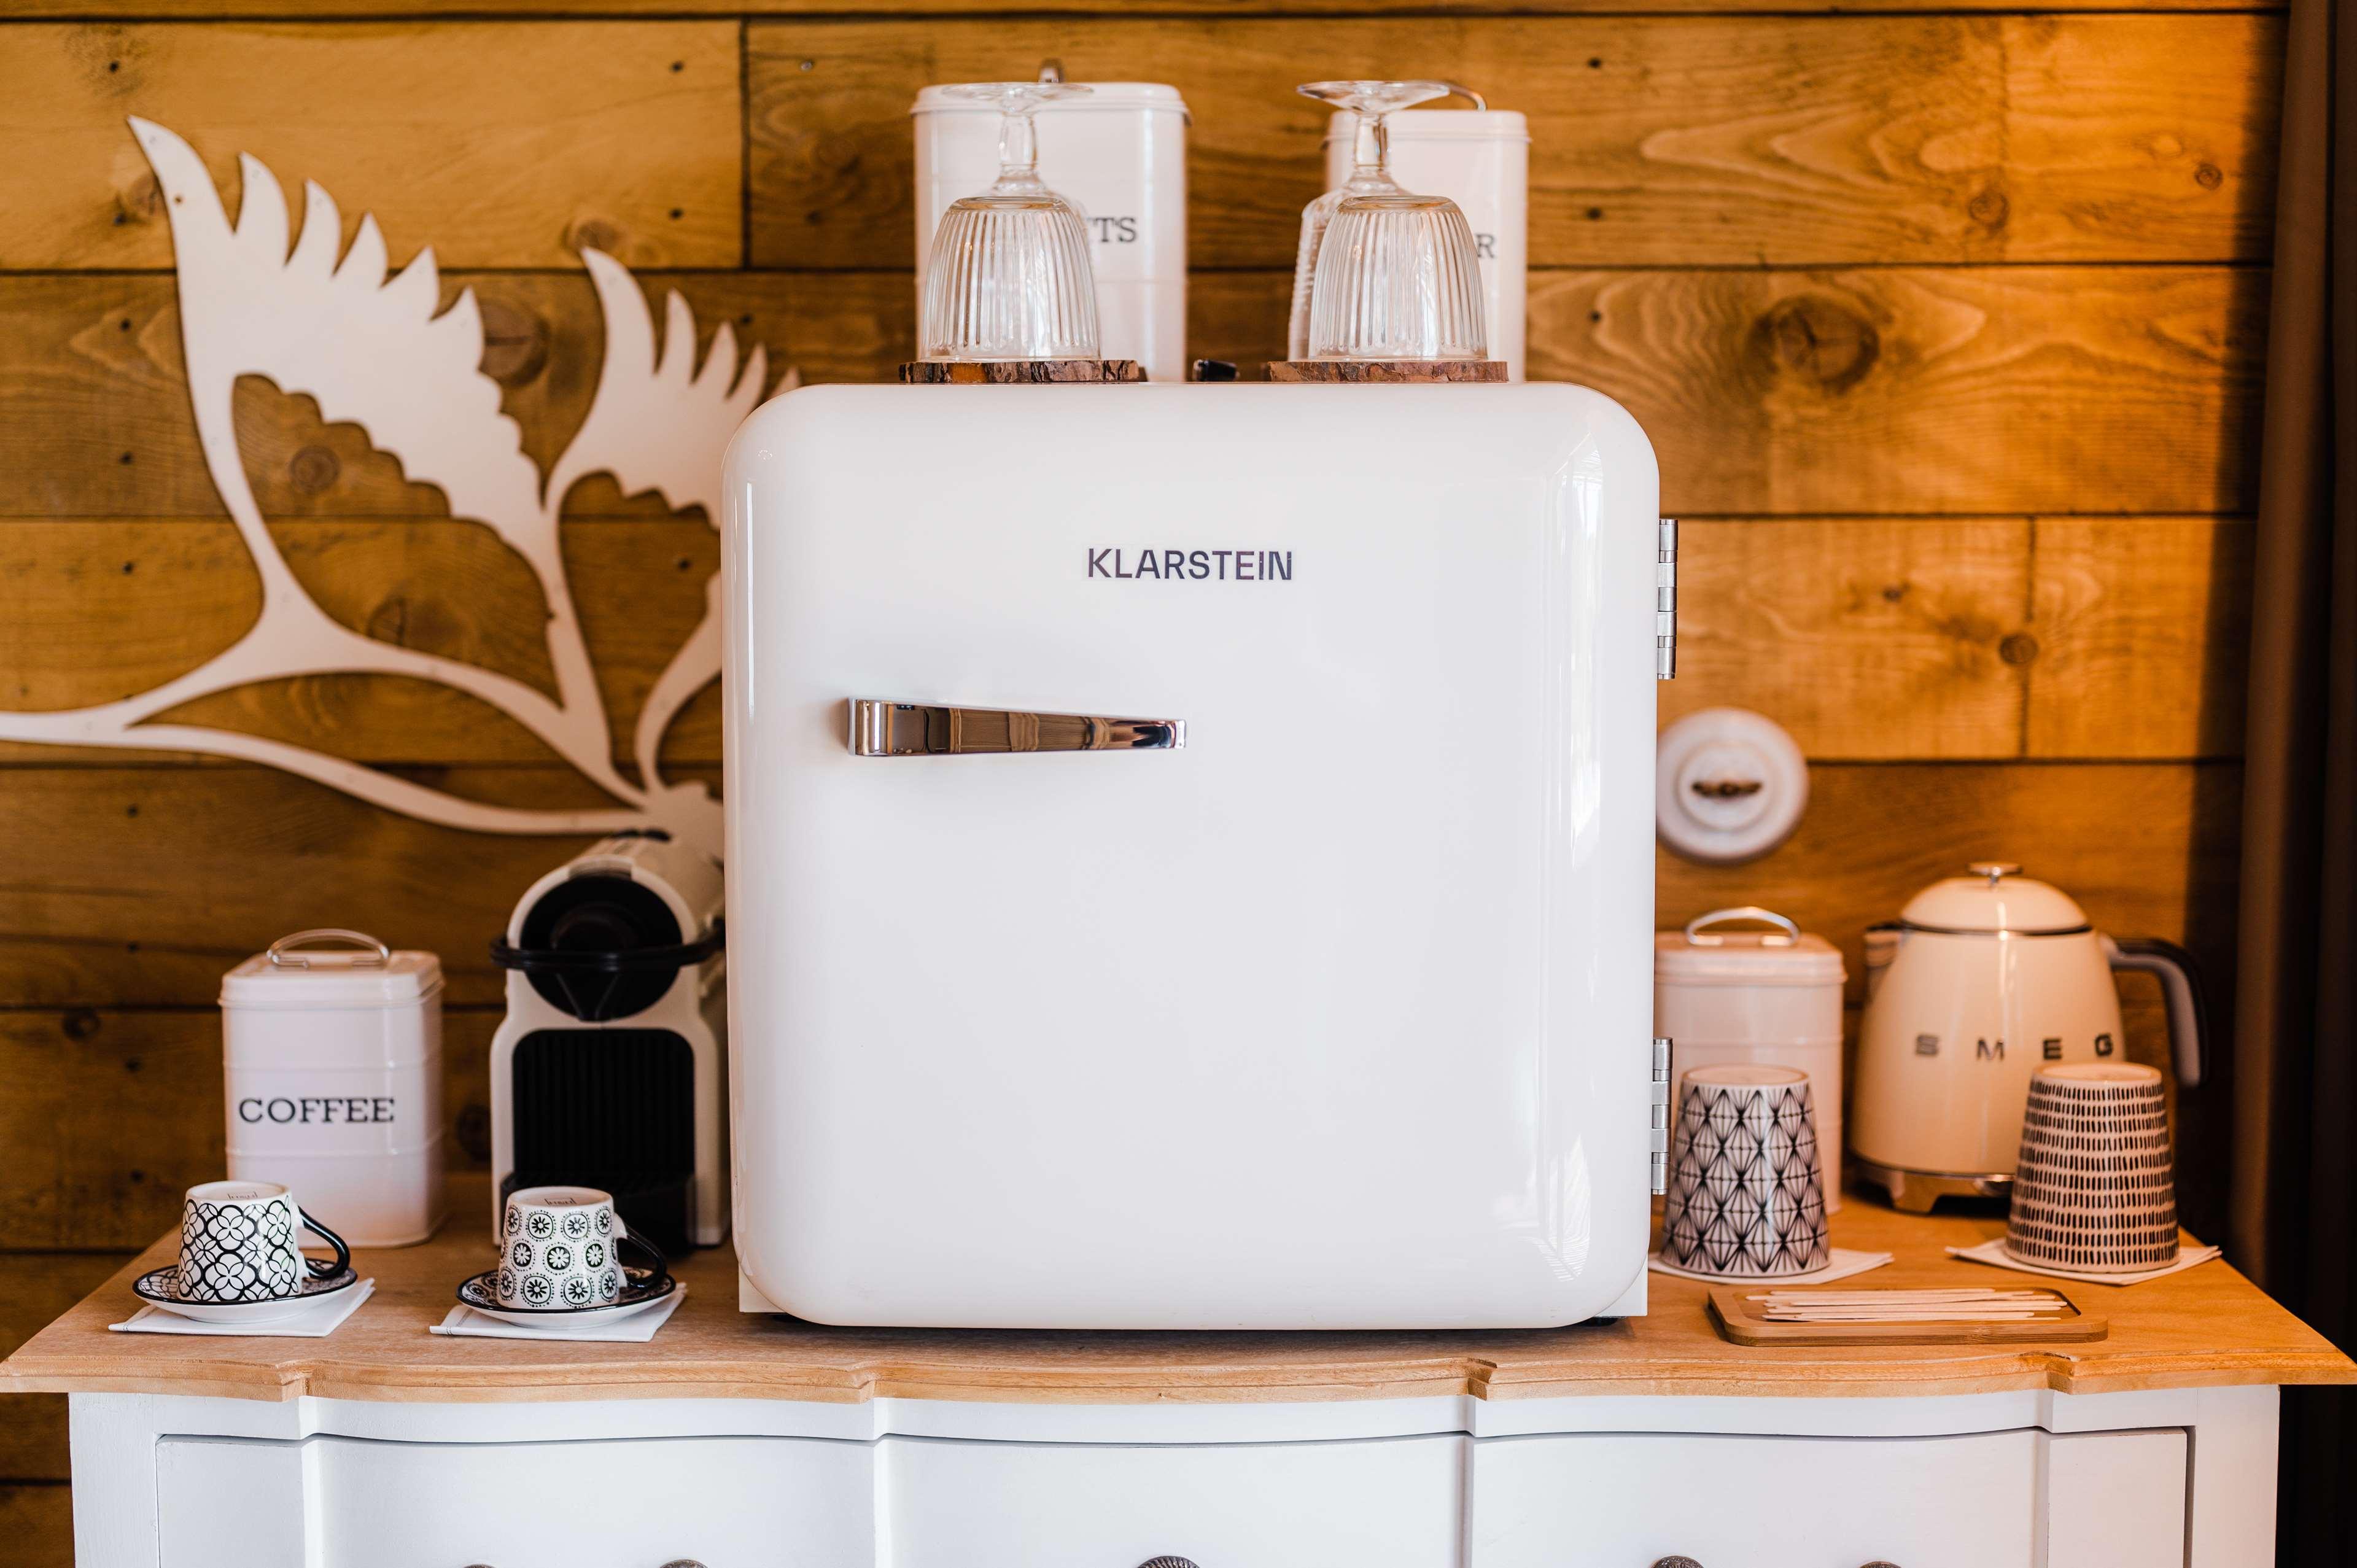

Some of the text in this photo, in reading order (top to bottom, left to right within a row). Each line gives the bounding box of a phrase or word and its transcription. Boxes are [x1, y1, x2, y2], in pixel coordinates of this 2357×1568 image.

[1088, 548, 1292, 580] KLARSTEIN
[1915, 1033, 2113, 1061] SMEG
[239, 1098, 394, 1123] COFFEE
